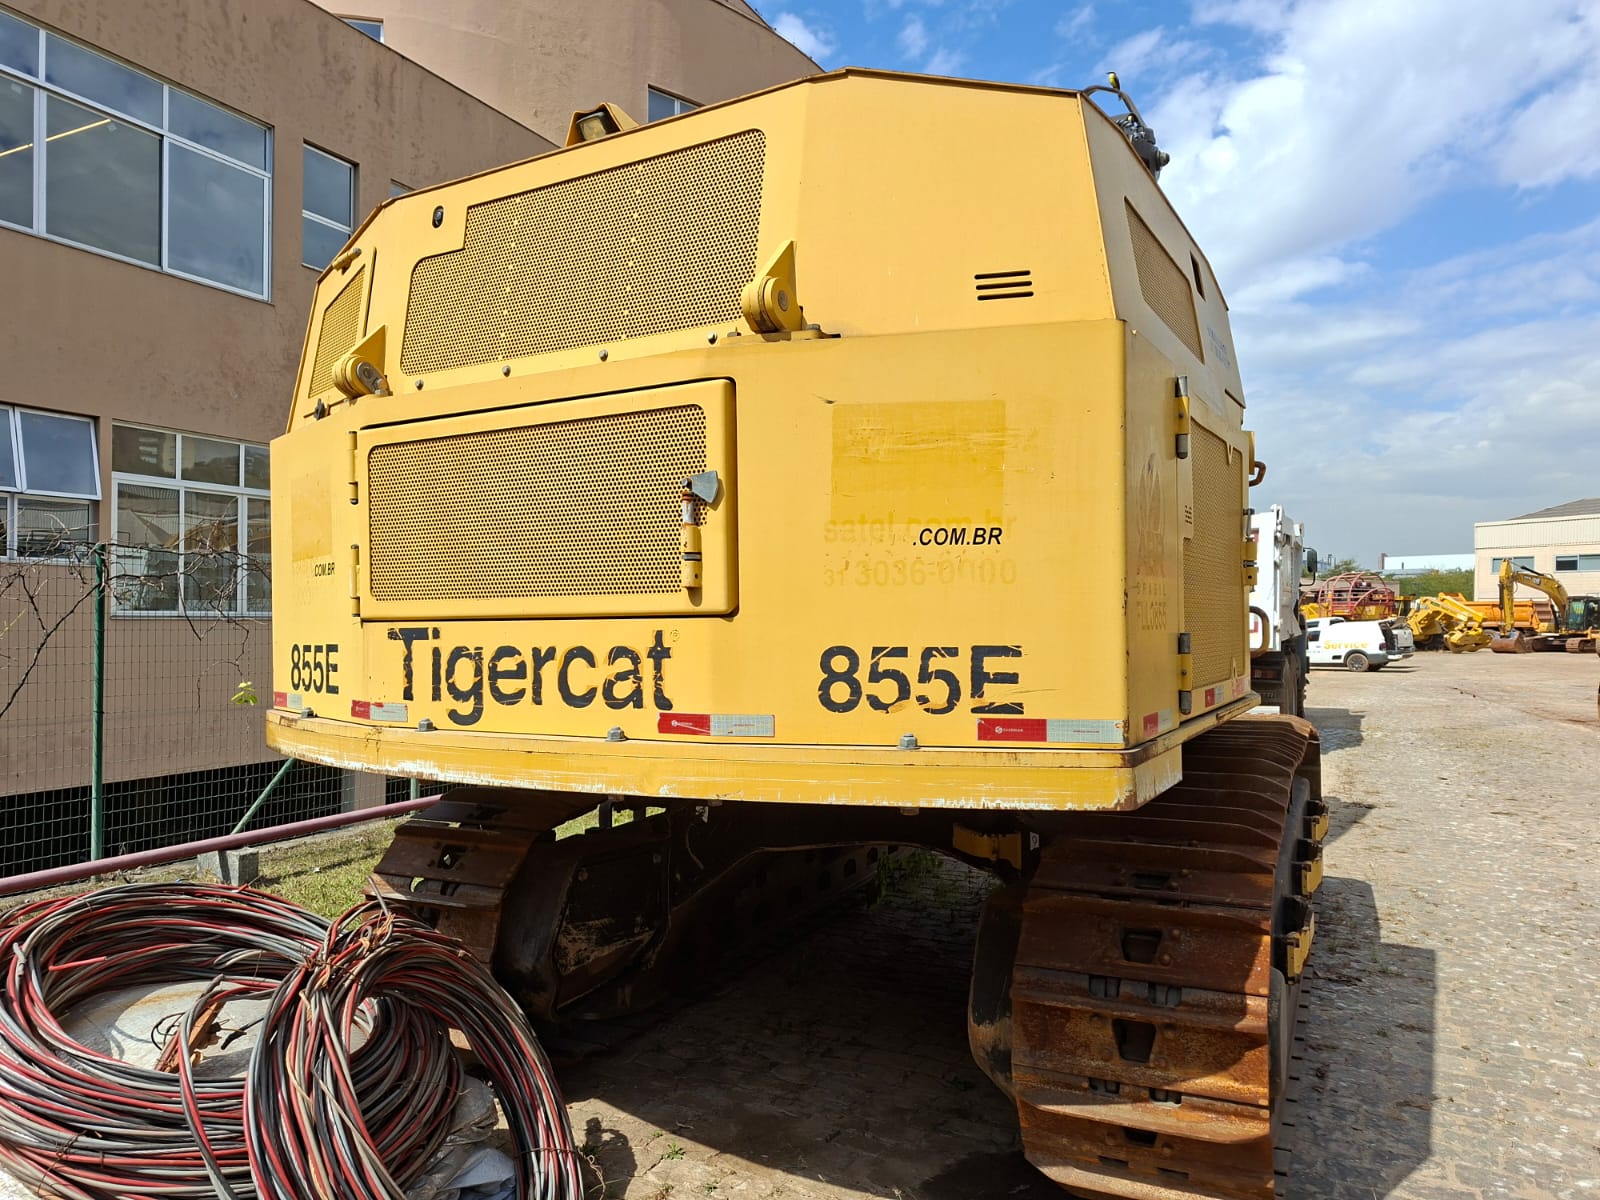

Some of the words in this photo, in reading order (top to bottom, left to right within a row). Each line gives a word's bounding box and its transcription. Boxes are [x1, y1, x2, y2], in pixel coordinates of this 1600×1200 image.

[912, 527, 1002, 546] .COM.BR
[291, 644, 339, 695] 855E
[387, 627, 673, 726] Tigercat
[818, 645, 1024, 714] 855E
